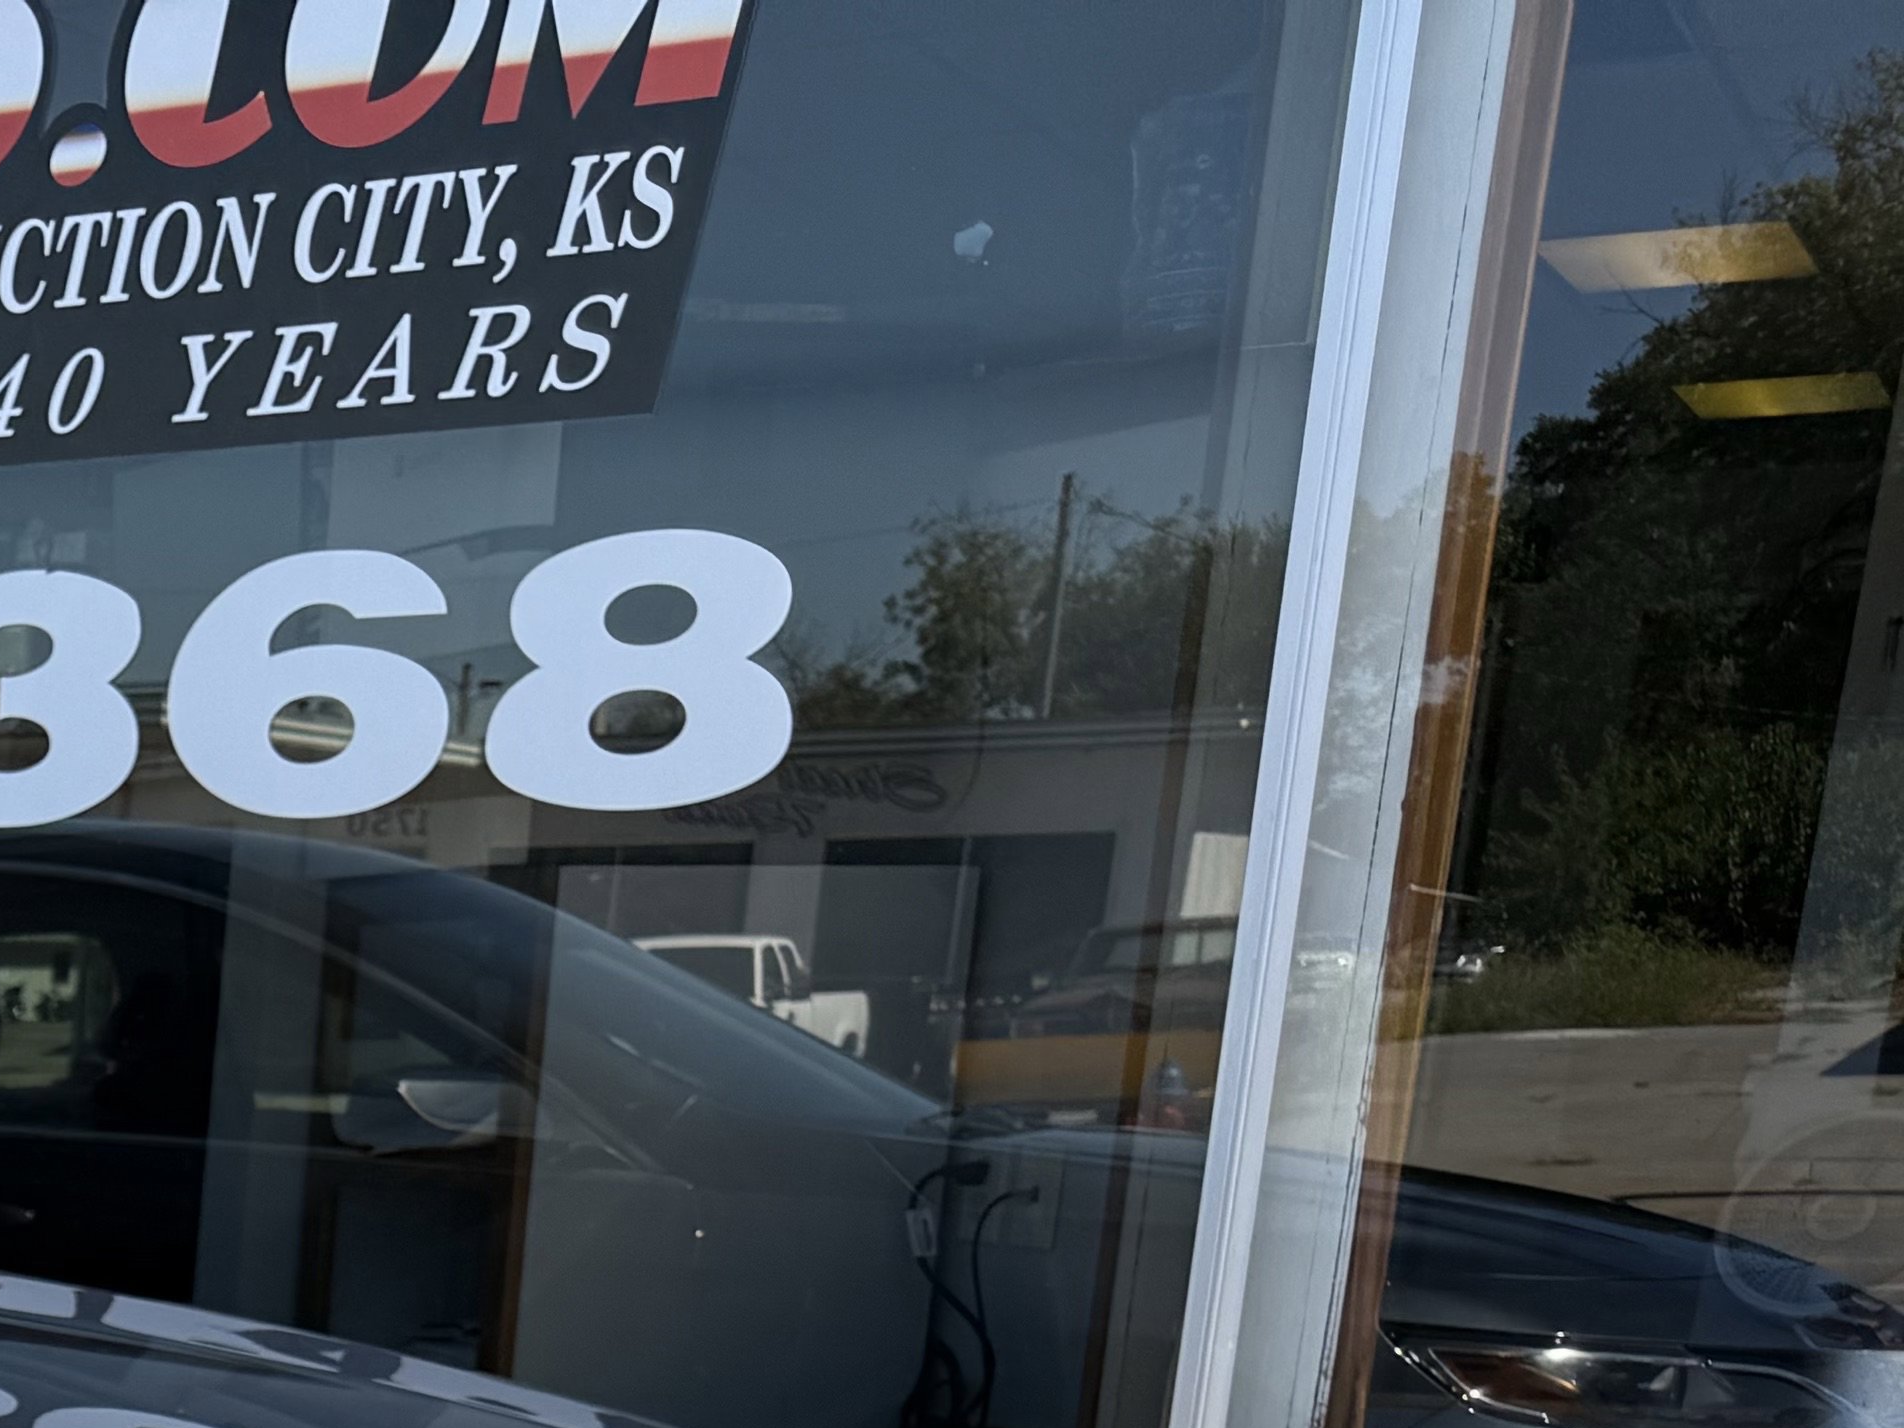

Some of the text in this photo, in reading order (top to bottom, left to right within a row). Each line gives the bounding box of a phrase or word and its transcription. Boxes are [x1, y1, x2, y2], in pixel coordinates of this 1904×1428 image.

[294, 164, 518, 284] CITY,
[545, 144, 685, 257] KS
[171, 292, 629, 424] YEARS
